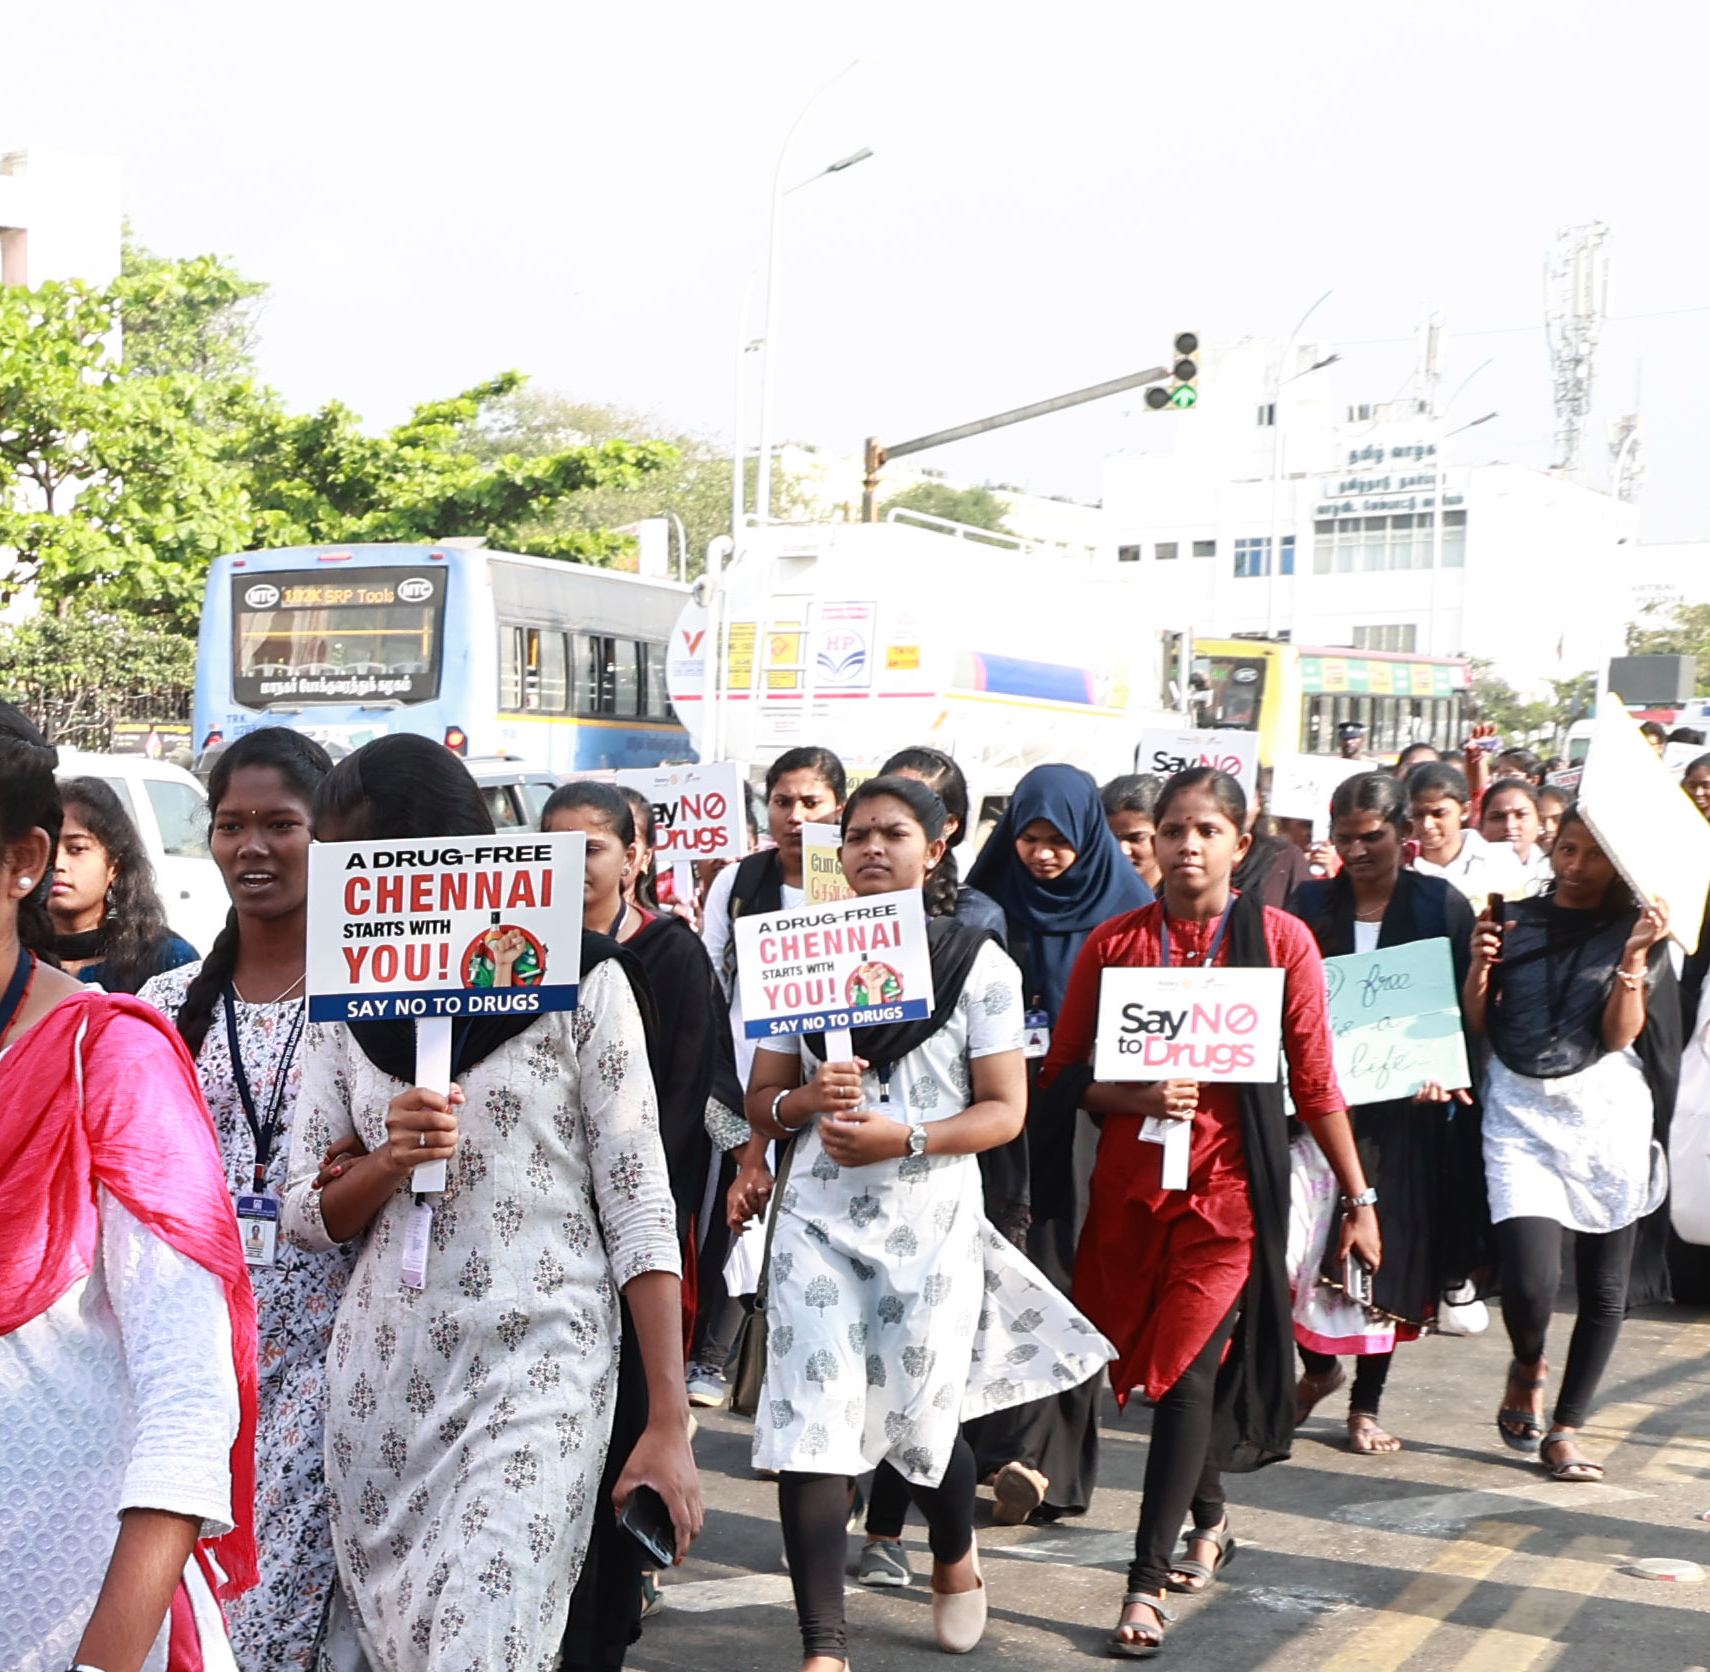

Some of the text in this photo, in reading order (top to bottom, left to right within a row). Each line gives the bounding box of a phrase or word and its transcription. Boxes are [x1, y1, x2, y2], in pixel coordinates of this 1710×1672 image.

[249, 590, 278, 604] MTC
[324, 589, 353, 604] SRP
[356, 588, 395, 604] Tools
[402, 582, 430, 598] MTC
[826, 636, 856, 651] HP
[260, 677, 298, 696] மாநகர்
[652, 793, 727, 829] ay NO
[654, 824, 729, 854] Drugs
[345, 845, 553, 870] A DRUG-FREE
[344, 868, 553, 915] CHENNAI
[343, 919, 451, 939] STARTS WITH
[758, 904, 898, 934] A DRUG-FREE
[759, 921, 901, 965] CHENNAI
[342, 943, 450, 985] YOU!
[762, 962, 835, 980] STARTS WITH
[763, 977, 836, 1011] YOU!
[1355, 963, 1416, 1008] free
[347, 994, 540, 1018] SAY NO TO DRUGS
[770, 1006, 903, 1034] SAY NO TO DRUGS
[1120, 1003, 1259, 1040] Say NO
[1118, 1036, 1255, 1074] to Drugs
